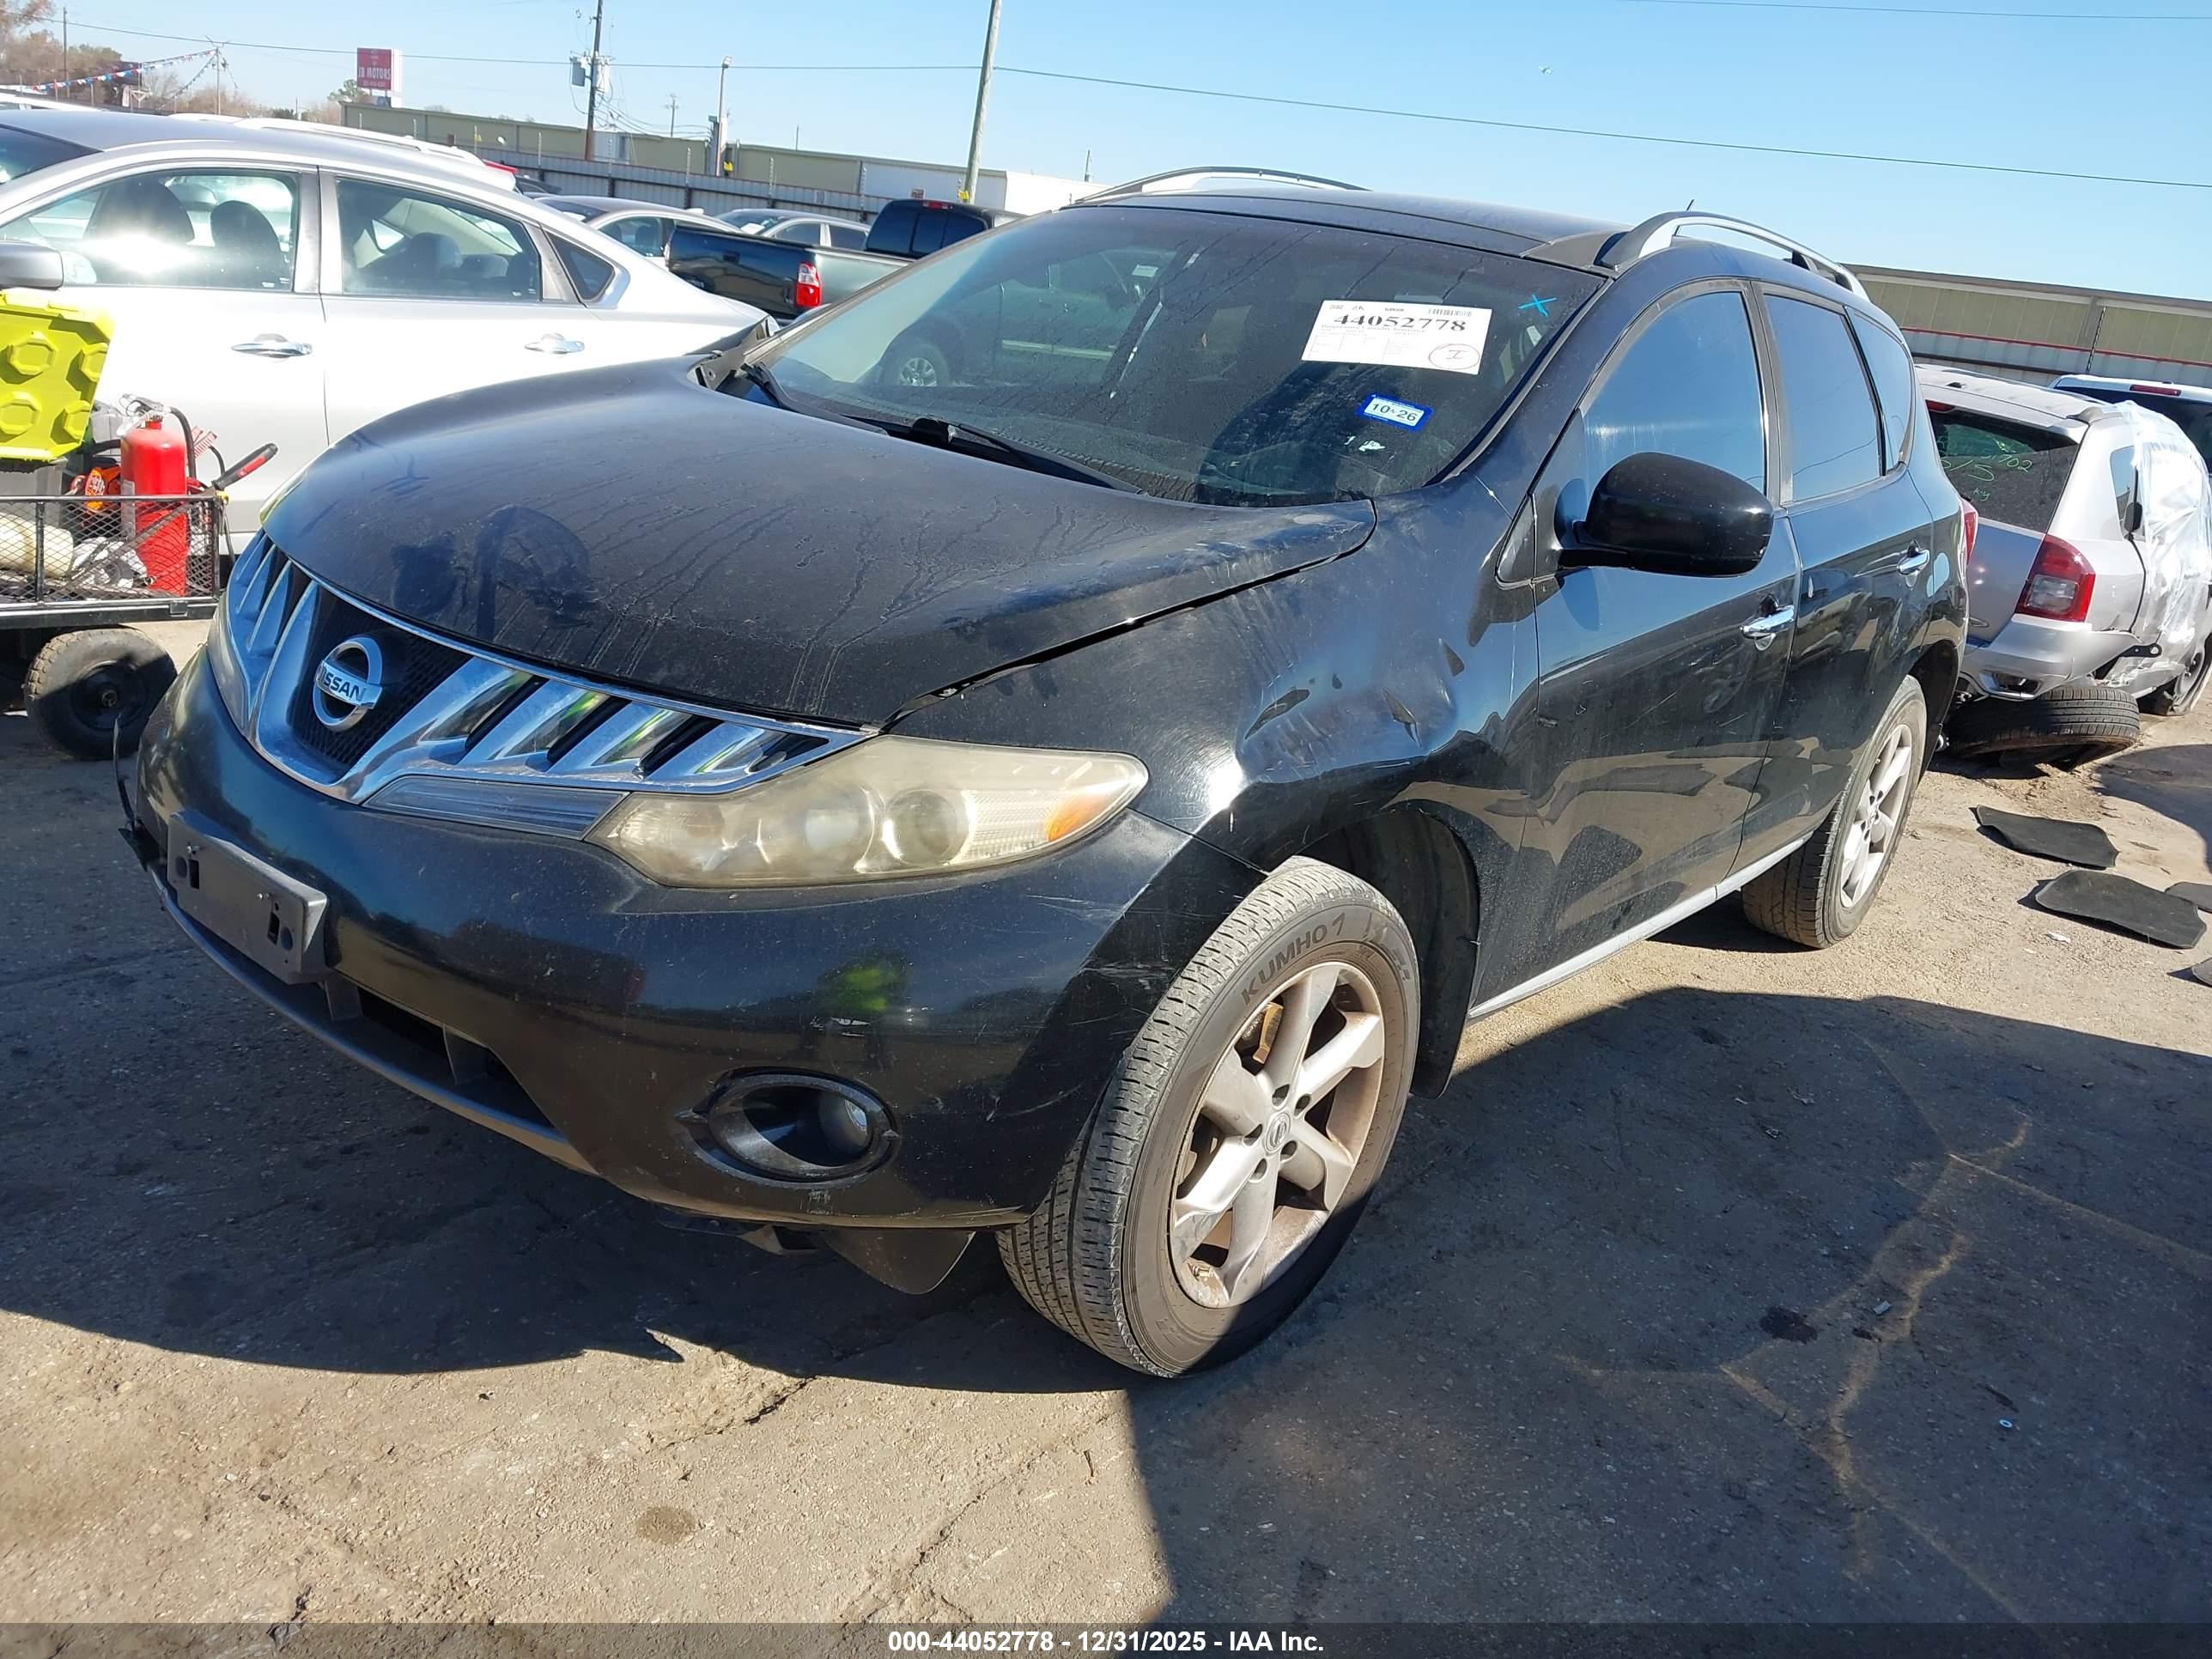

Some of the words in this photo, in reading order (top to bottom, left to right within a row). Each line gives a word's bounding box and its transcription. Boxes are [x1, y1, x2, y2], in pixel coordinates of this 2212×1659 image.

[367, 67, 391, 80] MOTORS
[1334, 314, 1467, 331] 44052778
[315, 662, 367, 702] NISSAN
[1241, 924, 1328, 1005] KUMHO
